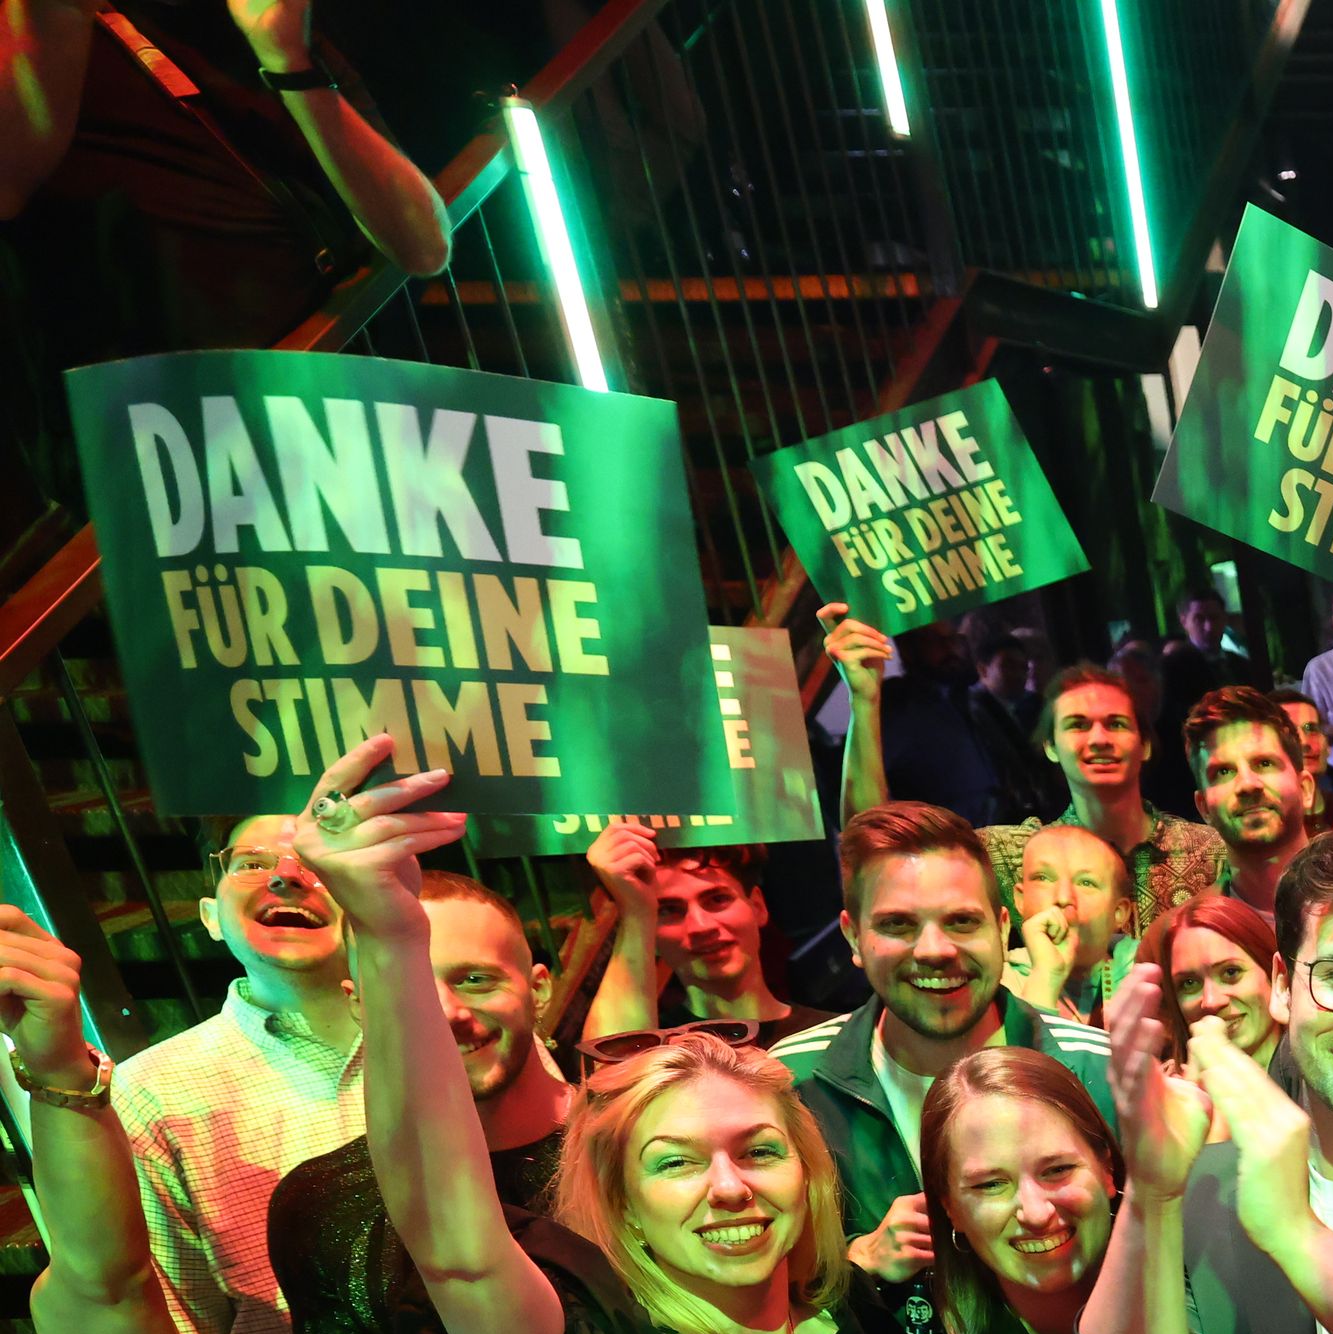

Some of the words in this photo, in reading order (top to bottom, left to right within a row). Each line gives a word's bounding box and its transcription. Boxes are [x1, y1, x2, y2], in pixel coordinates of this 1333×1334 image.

[128, 395, 584, 569] DANKE
[794, 410, 994, 533] DANKE
[830, 518, 904, 579] FÜR
[912, 479, 1022, 547] DEINE
[891, 533, 1022, 614] STIMME
[162, 563, 298, 670] FÜR
[306, 566, 609, 676] DEINE
[231, 678, 561, 778] STIMME
